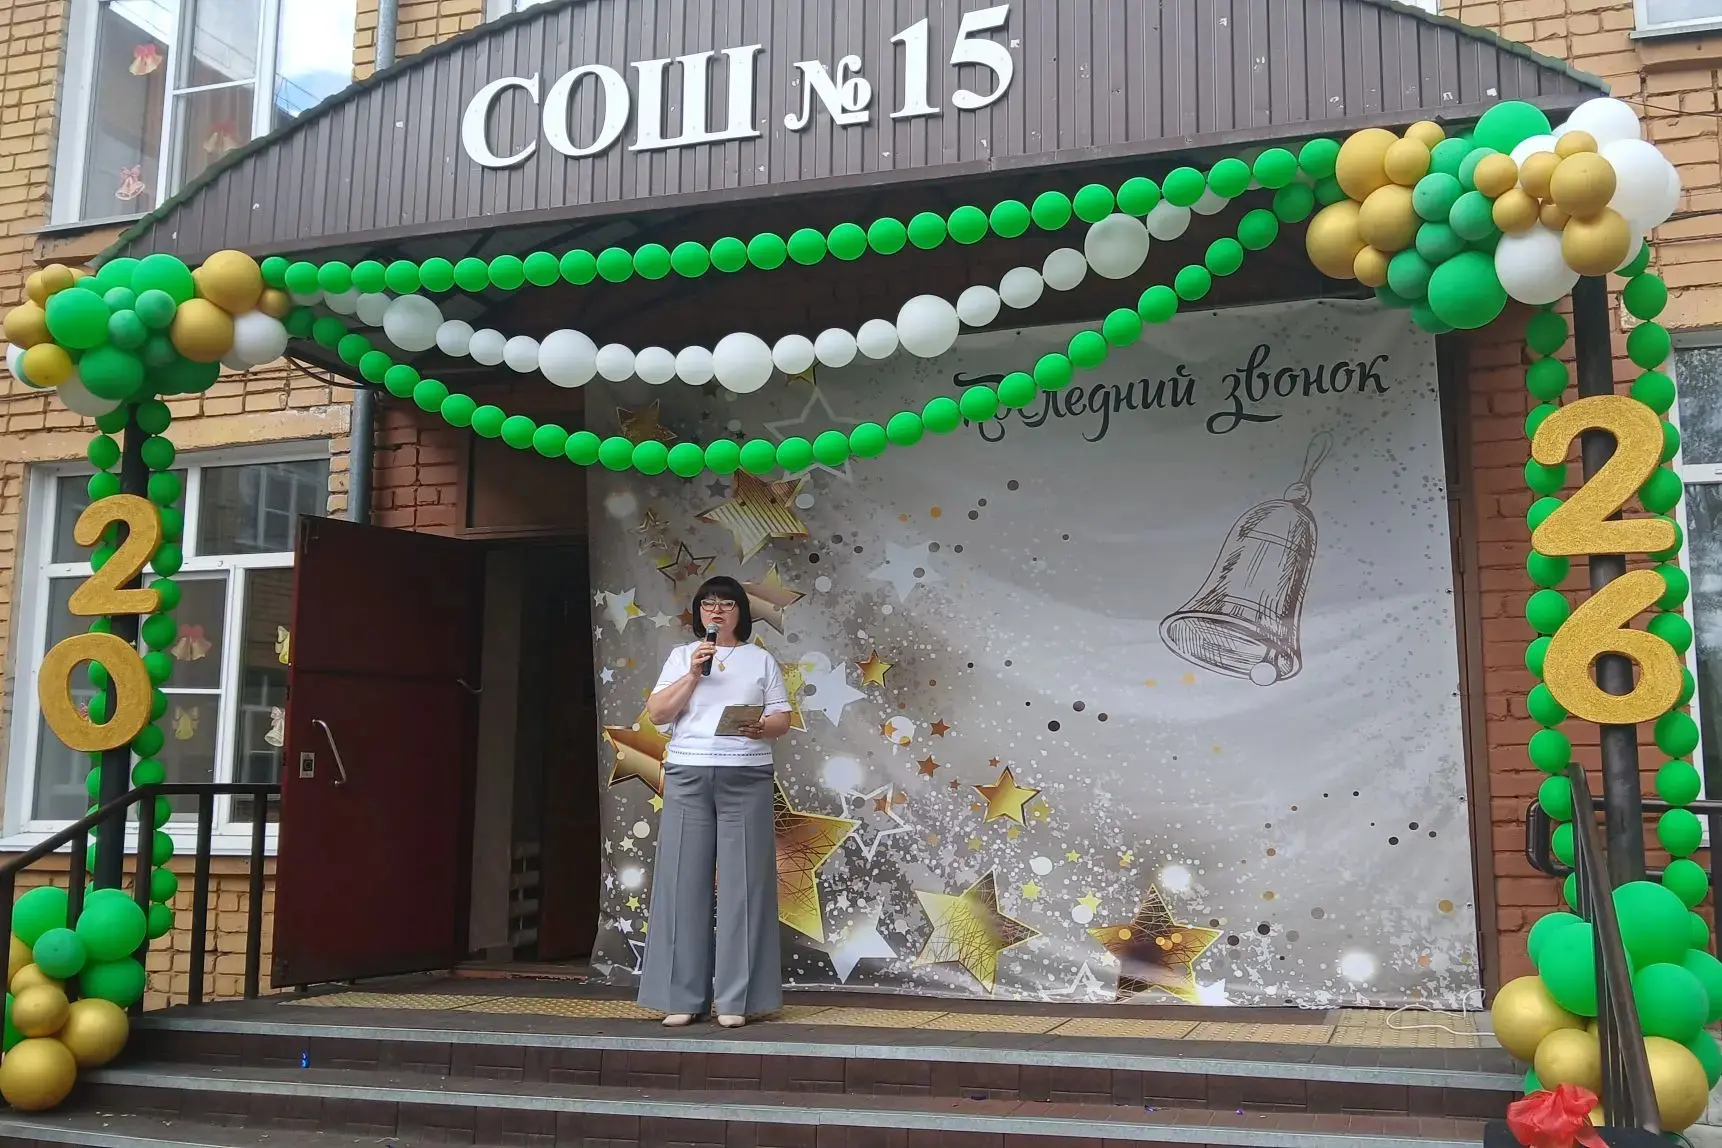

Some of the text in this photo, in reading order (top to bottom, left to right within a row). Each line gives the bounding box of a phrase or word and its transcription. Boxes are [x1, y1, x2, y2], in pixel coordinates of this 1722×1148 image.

[461, 5, 1014, 168] СОШ № 15
[953, 343, 1390, 443] ледний звонок
